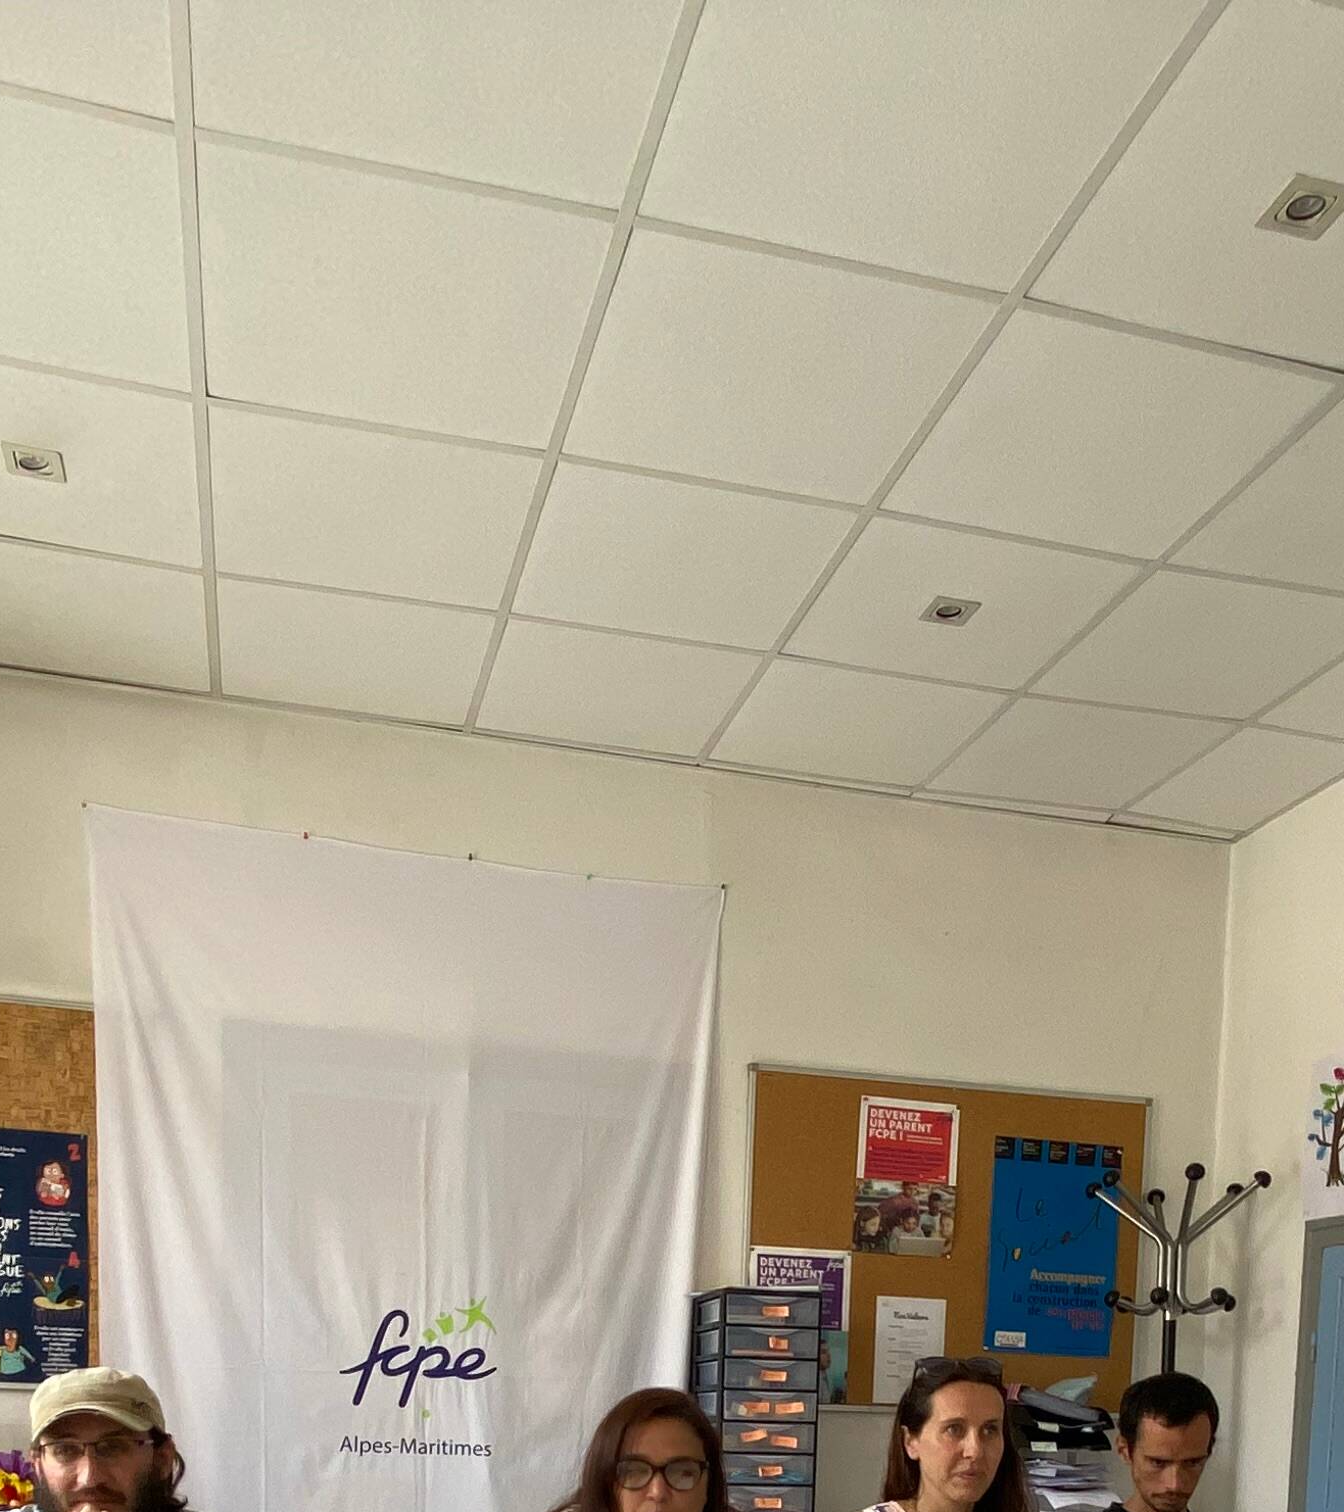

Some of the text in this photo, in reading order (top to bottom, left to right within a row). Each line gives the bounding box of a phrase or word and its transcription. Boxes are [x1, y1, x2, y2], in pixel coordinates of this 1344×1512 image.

[870, 1108, 921, 1122] DEVENEZ
[870, 1118, 933, 1133] UN PARENT
[869, 1128, 897, 1140] FCPE
[68, 1143, 81, 1161] 2
[760, 1257, 812, 1268] DEVENEZ
[760, 1267, 824, 1279] UN PARENT
[1030, 1268, 1106, 1285] Accompagner
[760, 1277, 789, 1286] FCPE
[1073, 1284, 1099, 1296] dans
[339, 1309, 497, 1408] fcpe
[339, 1435, 492, 1457] Alpes-Maritimes
